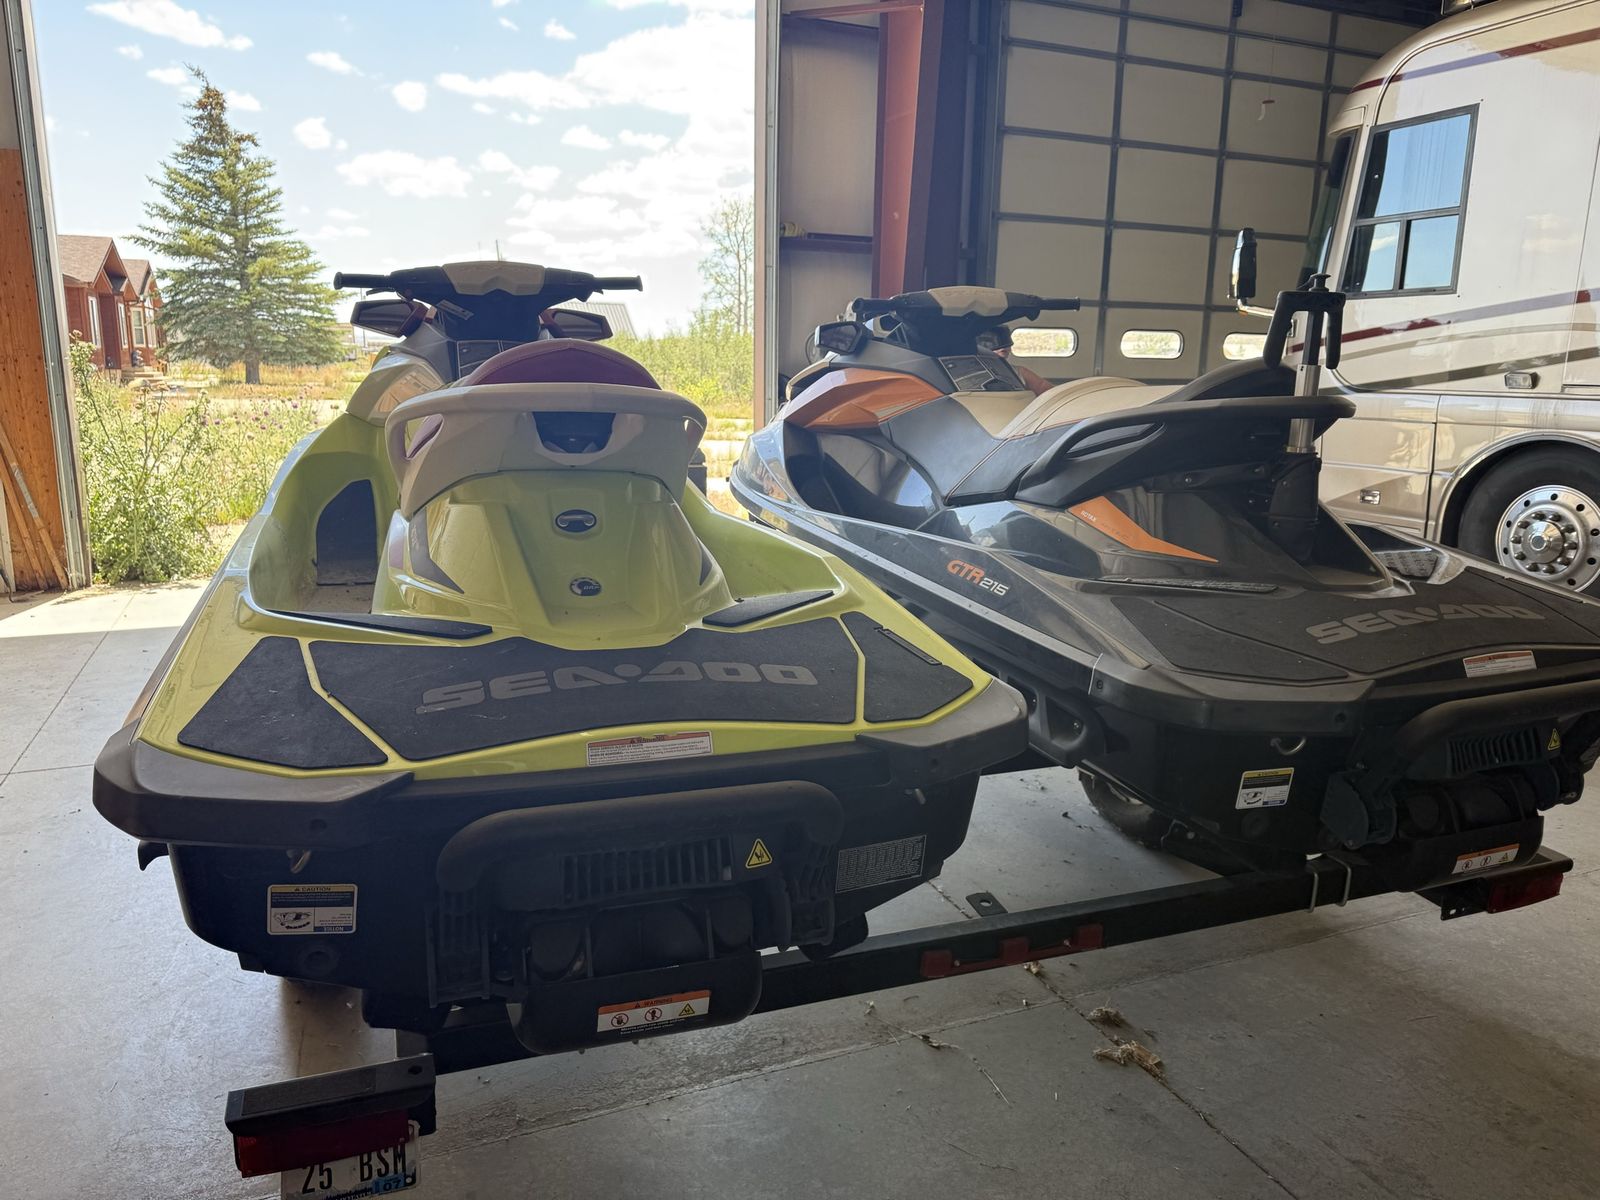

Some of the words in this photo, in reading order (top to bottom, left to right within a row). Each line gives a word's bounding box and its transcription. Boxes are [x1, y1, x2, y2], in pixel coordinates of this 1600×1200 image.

[947, 559, 985, 584] GTR
[979, 577, 1009, 596] 215
[360, 1143, 407, 1182] BSM
